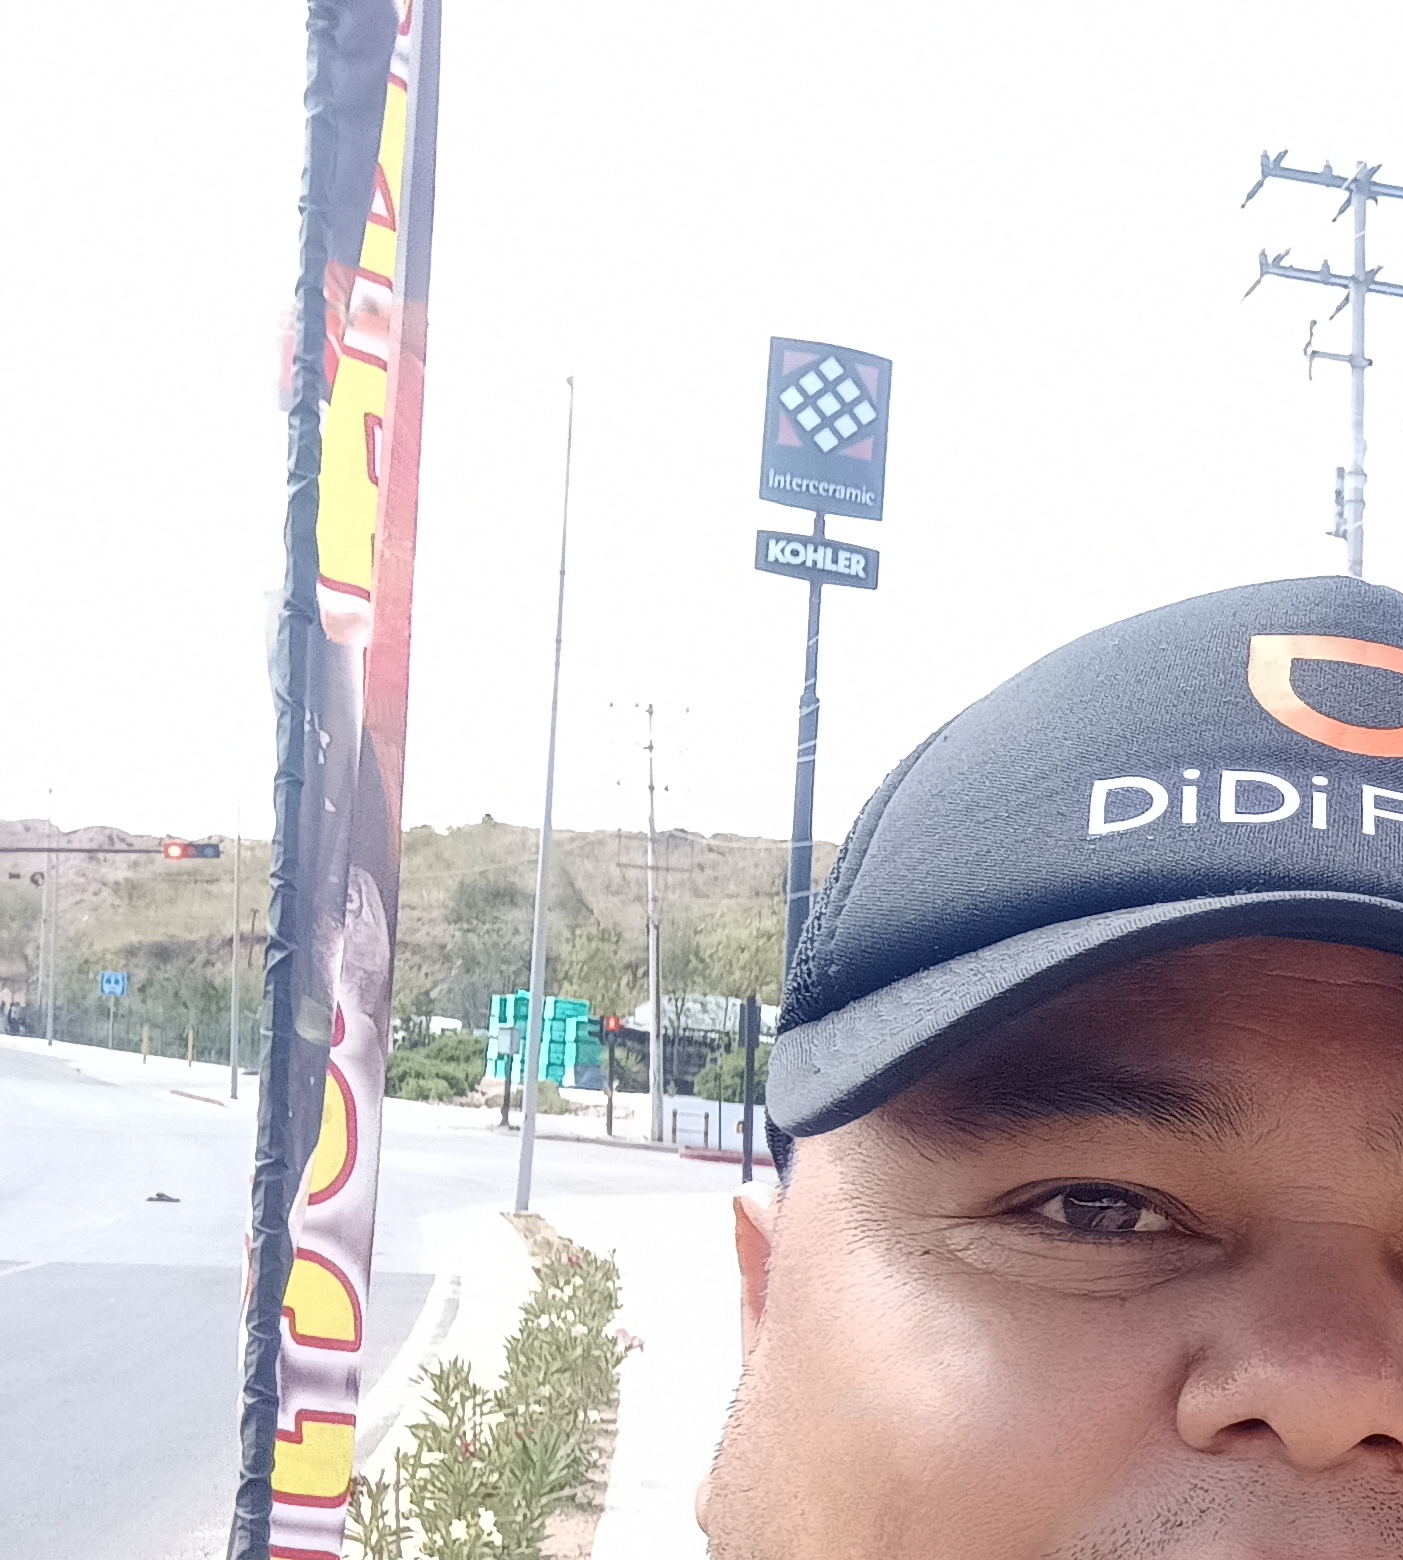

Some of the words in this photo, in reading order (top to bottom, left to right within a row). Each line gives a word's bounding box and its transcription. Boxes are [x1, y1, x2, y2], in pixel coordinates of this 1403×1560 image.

[768, 467, 877, 507] Interceramic
[767, 538, 867, 579] KOHLER
[1088, 767, 1331, 837] DiDi
